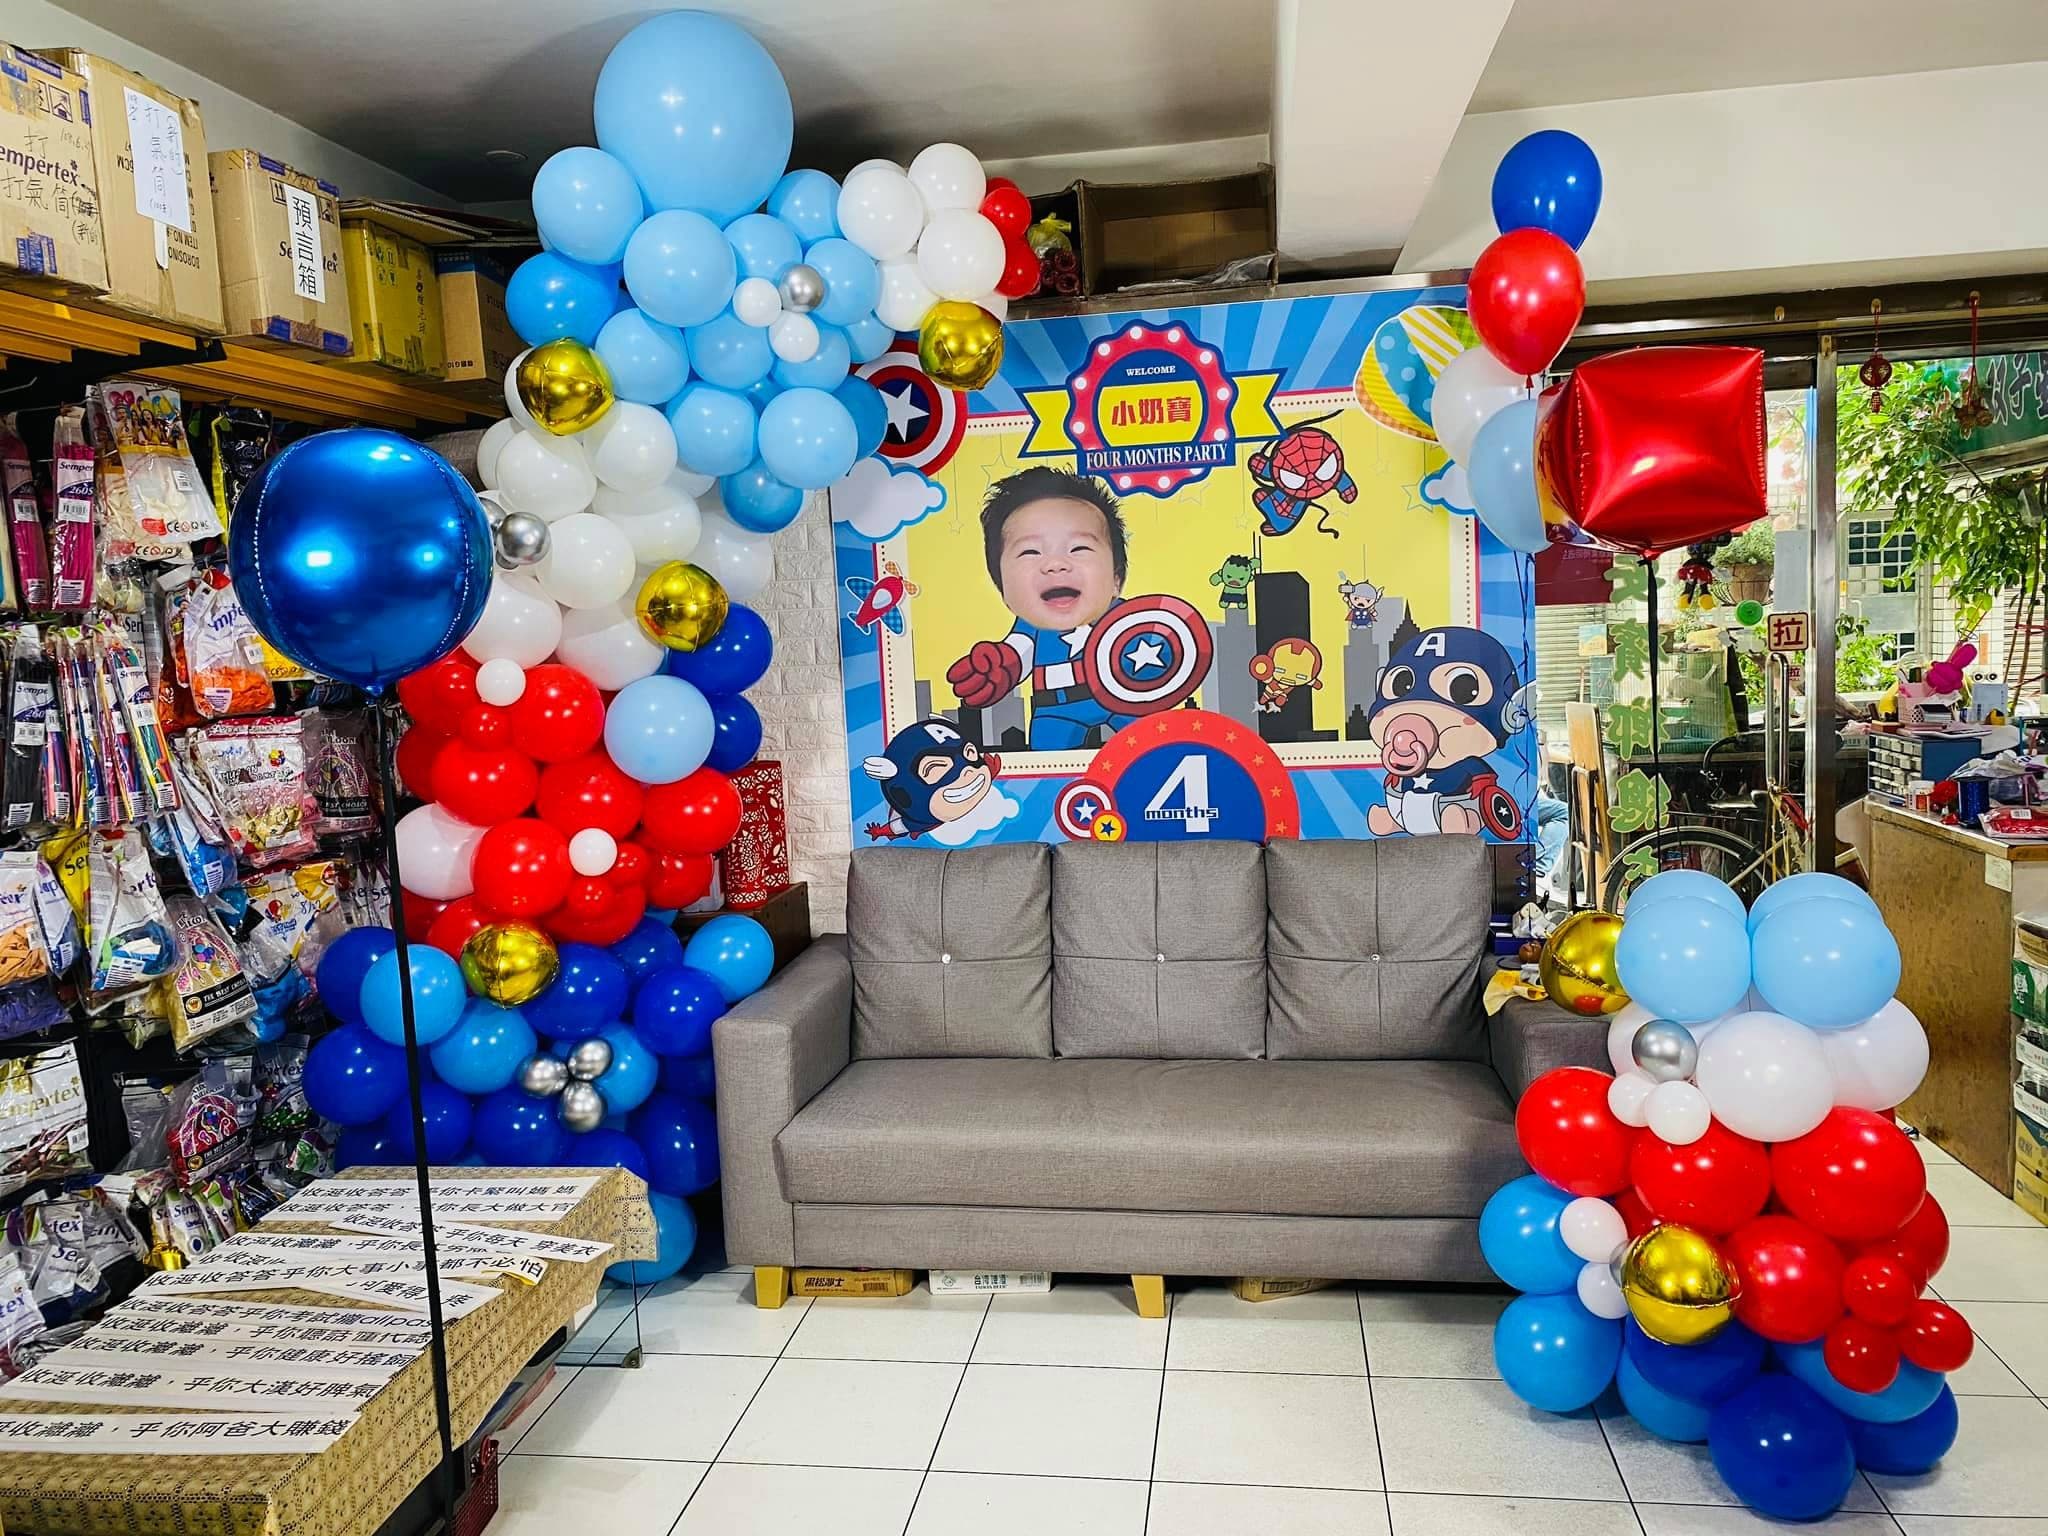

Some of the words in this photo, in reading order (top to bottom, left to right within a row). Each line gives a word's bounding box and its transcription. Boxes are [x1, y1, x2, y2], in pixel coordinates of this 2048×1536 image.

[292, 197, 317, 297] 預言箱
[1125, 365, 1176, 377] WELCOME
[1111, 396, 1192, 427] 小奶寶
[1086, 450, 1121, 469] FOUR
[1124, 446, 1182, 467] MONTHS
[1184, 443, 1228, 463] PARTY
[1414, 632, 1446, 657] A
[1772, 618, 1803, 647] 拉
[923, 723, 961, 745] A
[1145, 754, 1210, 833] 4
[1145, 806, 1219, 820] months
